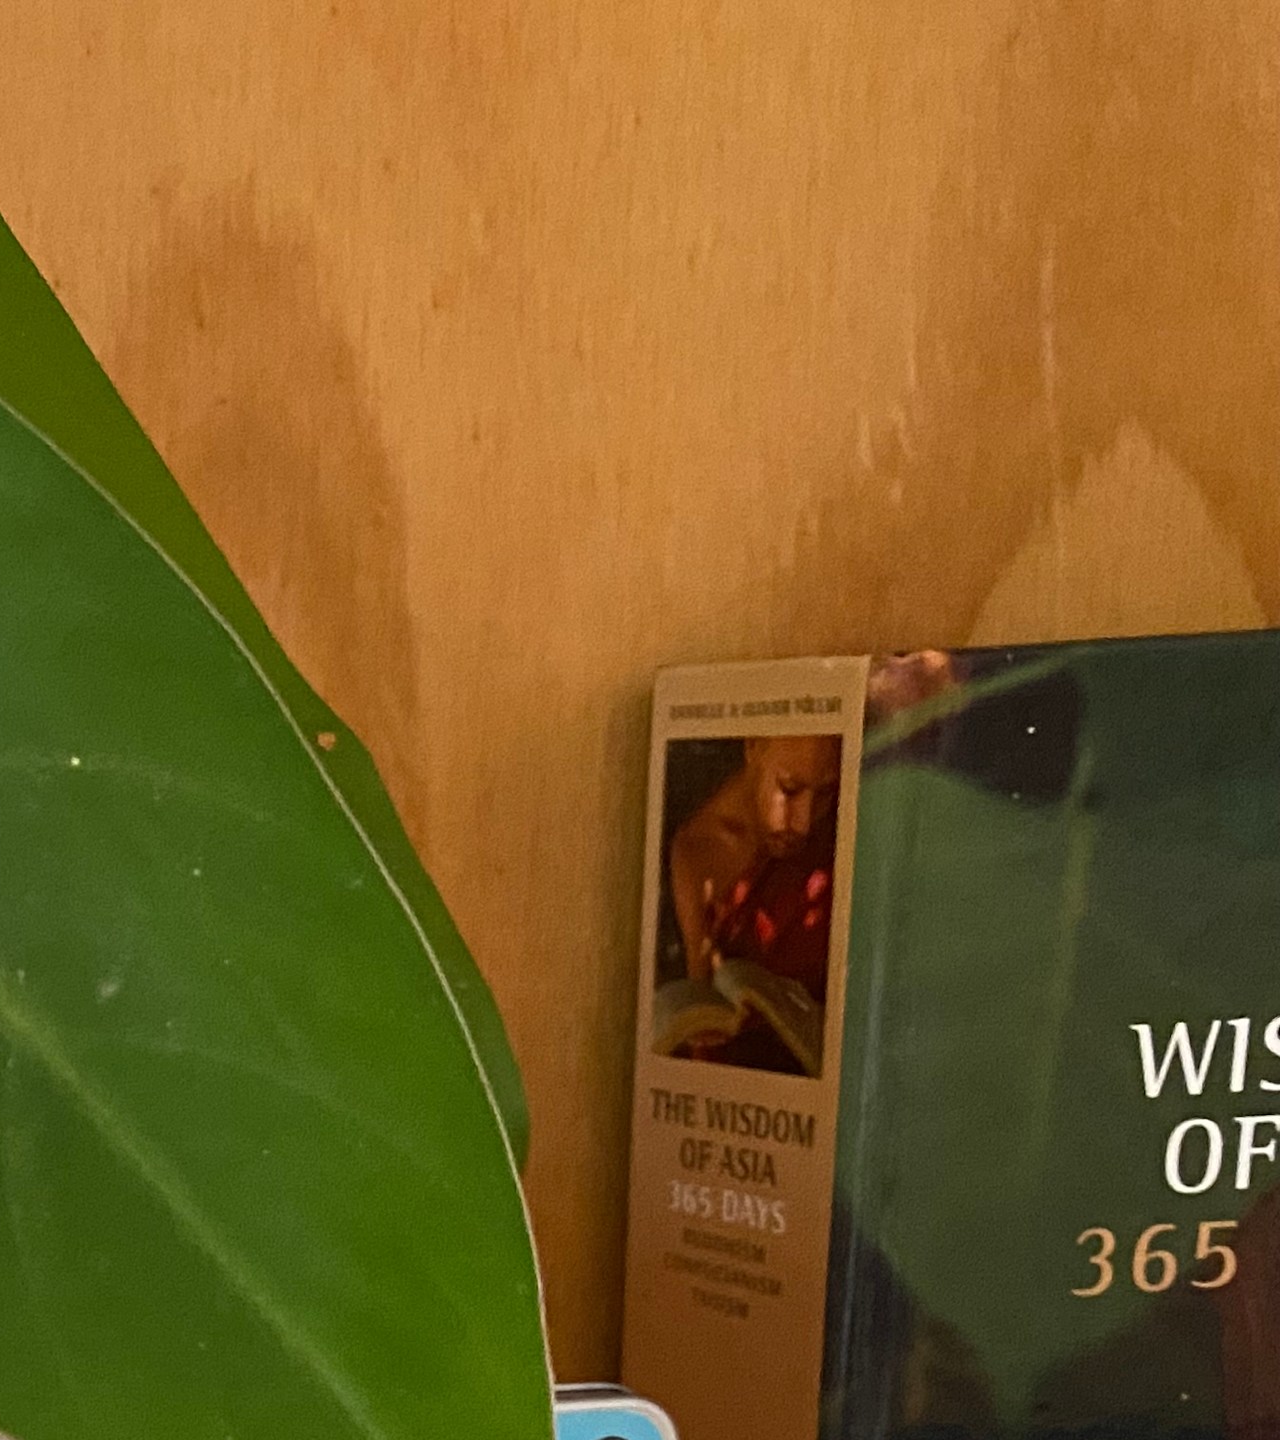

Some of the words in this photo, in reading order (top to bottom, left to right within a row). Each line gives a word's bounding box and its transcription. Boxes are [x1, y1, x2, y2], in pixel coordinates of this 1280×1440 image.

[650, 1087, 696, 1128] THE
[705, 1097, 815, 1147] WISDOM
[679, 1138, 713, 1172] OF
[719, 1145, 777, 1187] ASIA
[1164, 1114, 1280, 1194] OF
[670, 1180, 712, 1219] 365
[721, 1189, 786, 1234] DAYS
[1071, 1220, 1239, 1297] 365
